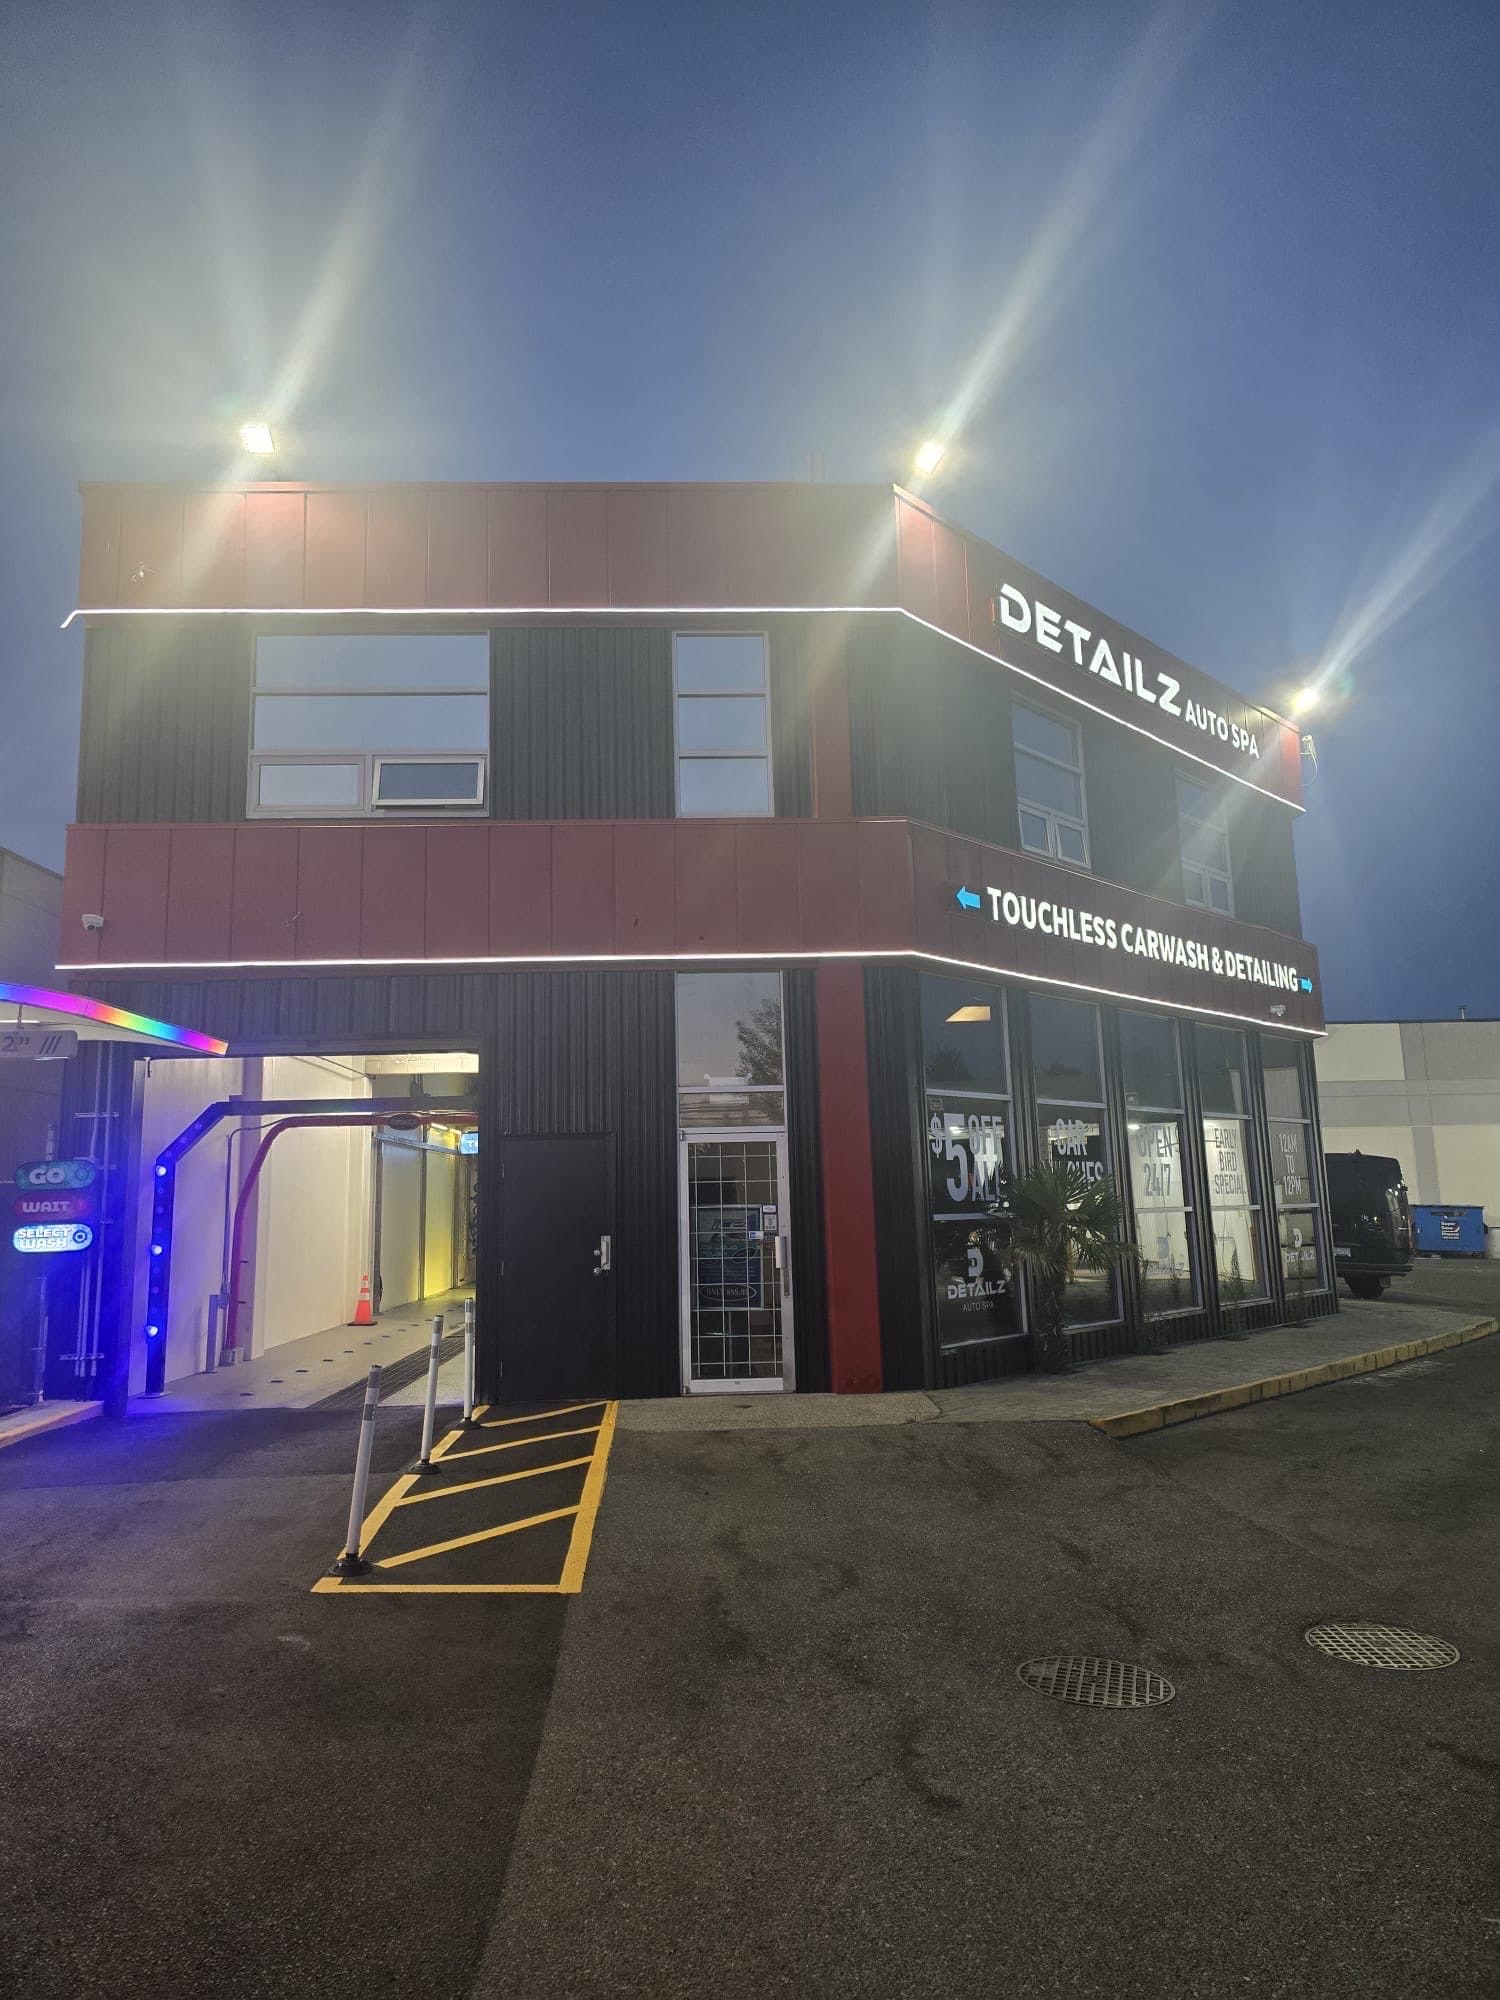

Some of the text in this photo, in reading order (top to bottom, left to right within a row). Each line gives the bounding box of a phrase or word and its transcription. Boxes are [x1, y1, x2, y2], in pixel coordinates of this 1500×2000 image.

[1000, 583, 1260, 759] DETAILZ AUTO SPA
[987, 886, 1298, 993] TOUCHLESS CARWASH & DETAILING
[968, 1114, 1004, 1163] OFF
[1056, 1118, 1088, 1156] CAR
[1138, 1126, 1173, 1158] OPEN
[1214, 1128, 1237, 1149] EARLY
[1279, 1133, 1298, 1153] 12AM
[1218, 1152, 1238, 1172] BIRD
[1285, 1155, 1295, 1173] TO
[29, 1168, 65, 1184] GO
[1214, 1174, 1247, 1195] SPECIAL
[1283, 1176, 1302, 1195] 12PM
[22, 1201, 71, 1213] WAIT
[18, 1227, 72, 1238] SELECT
[18, 1238, 69, 1249] WASH
[947, 1280, 1006, 1299] DETAILZ
[963, 1302, 981, 1312] AUTO
